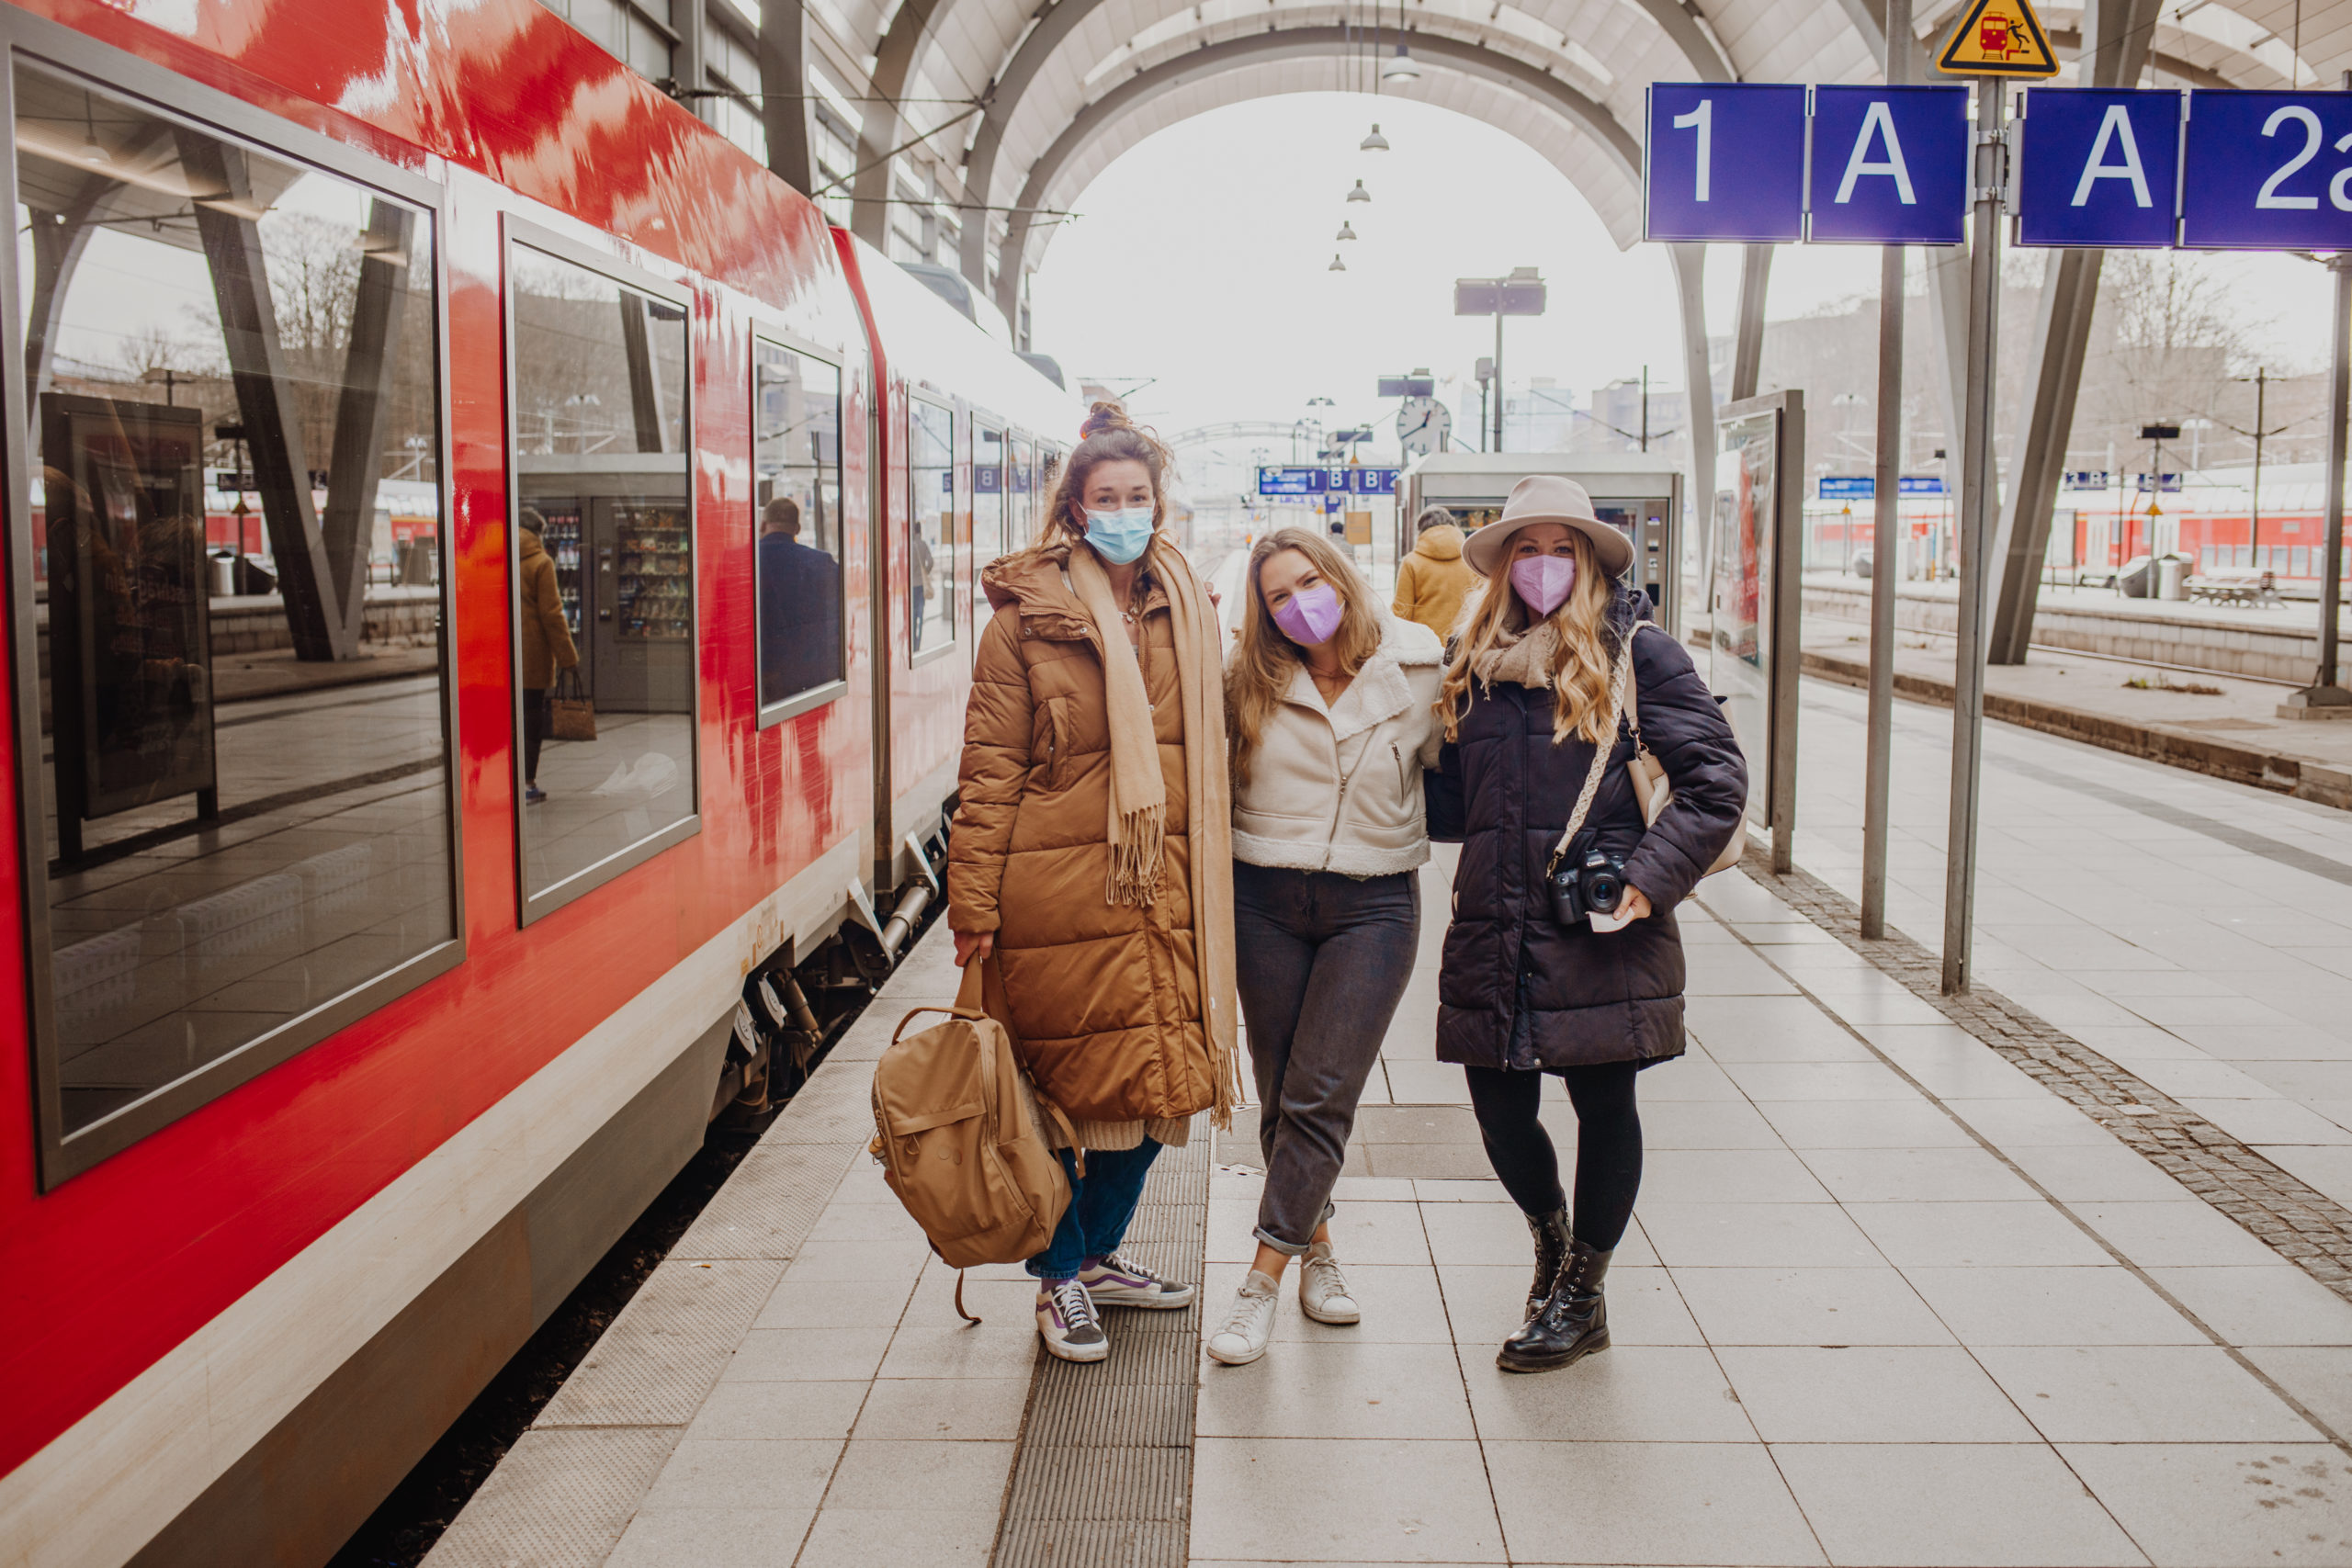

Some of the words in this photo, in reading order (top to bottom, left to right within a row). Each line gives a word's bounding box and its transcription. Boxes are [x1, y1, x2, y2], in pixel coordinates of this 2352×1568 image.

[1672, 98, 1712, 202] 1
[1834, 101, 1917, 205] A
[2070, 104, 2154, 208] A
[1308, 471, 1317, 488] 1
[1330, 470, 1343, 488] B
[1365, 470, 1378, 488] B
